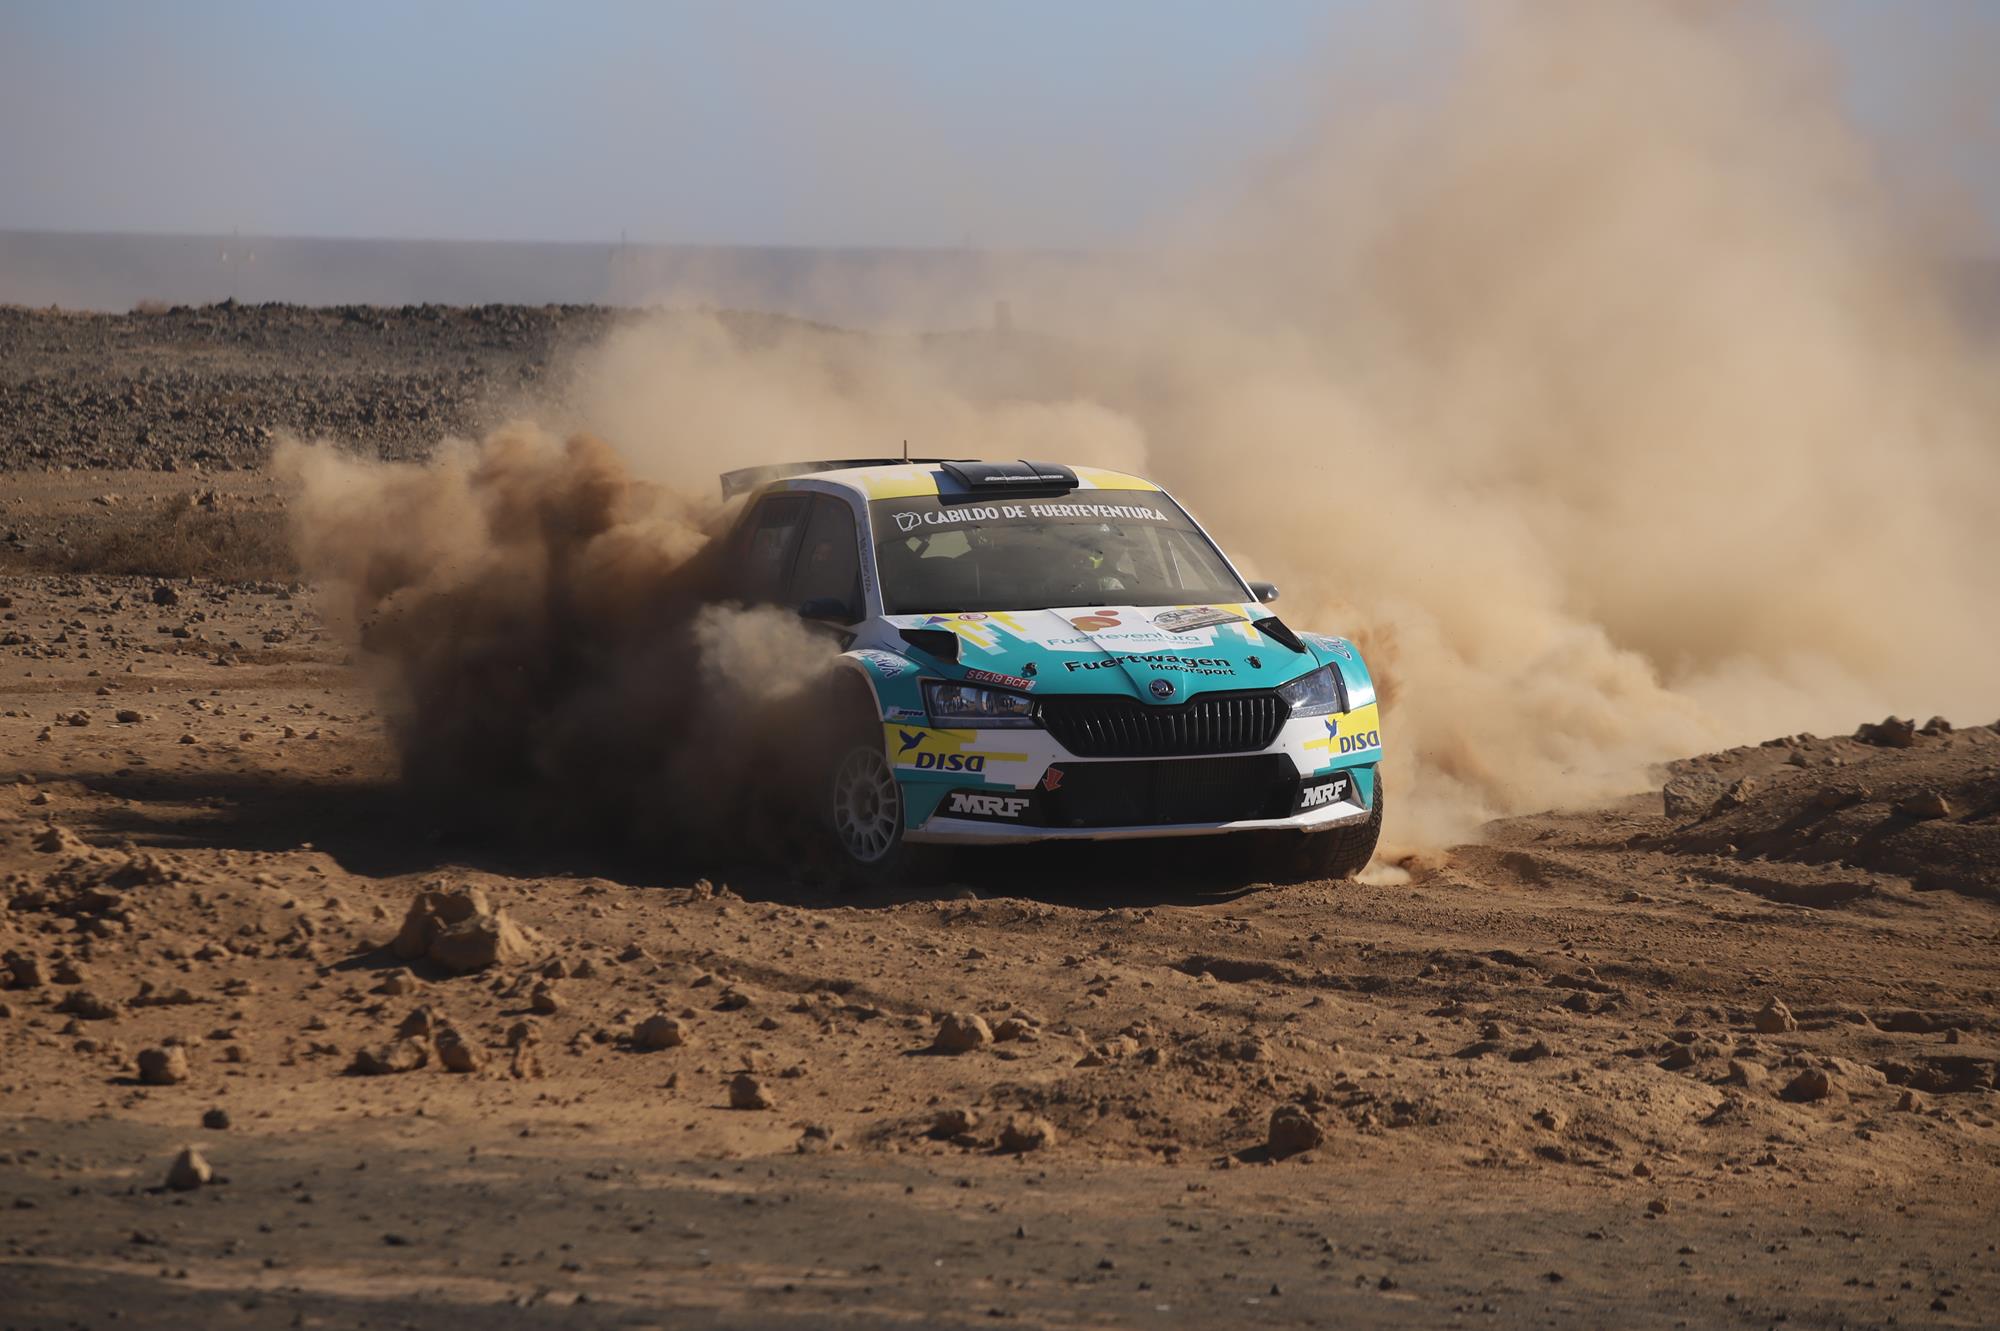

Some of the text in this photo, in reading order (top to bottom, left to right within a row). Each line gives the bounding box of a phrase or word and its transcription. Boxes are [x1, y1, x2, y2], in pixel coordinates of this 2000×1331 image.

[924, 504, 1168, 525] CABILDO DE FUERTEVENTURA
[1047, 632, 1200, 646] Fuerteventura
[1063, 654, 1232, 673] Fuertwagen
[1149, 663, 1236, 677] Motorsport
[975, 670, 1004, 684] 6419
[1004, 677, 1028, 689] BCF
[1301, 779, 1347, 808] MRF
[949, 793, 1030, 817] MRF
